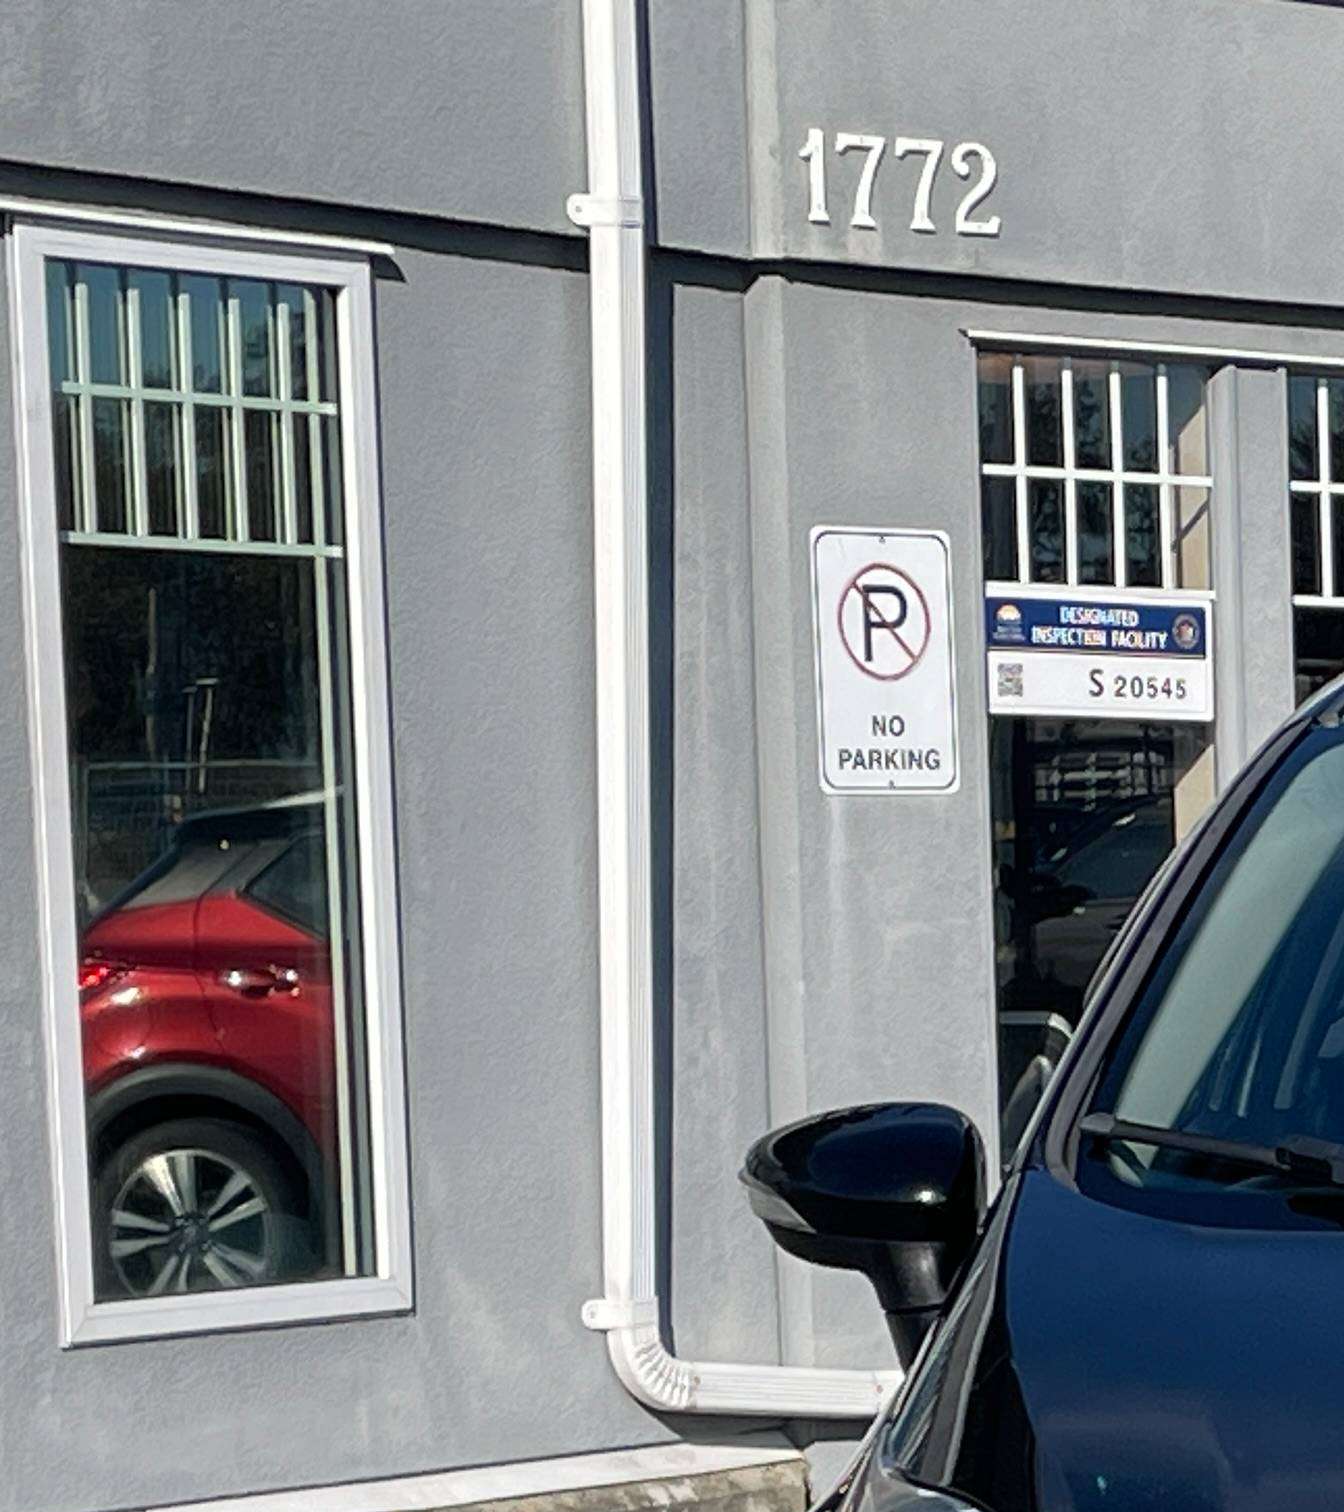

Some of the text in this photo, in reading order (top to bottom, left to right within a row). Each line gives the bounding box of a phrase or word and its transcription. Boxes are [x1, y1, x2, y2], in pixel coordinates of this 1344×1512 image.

[799, 128, 1001, 235] 1772
[1111, 629, 1169, 649] FACILITY
[1089, 668, 1187, 699] S 20545
[871, 715, 905, 737] NO
[837, 748, 941, 771] PARKING
